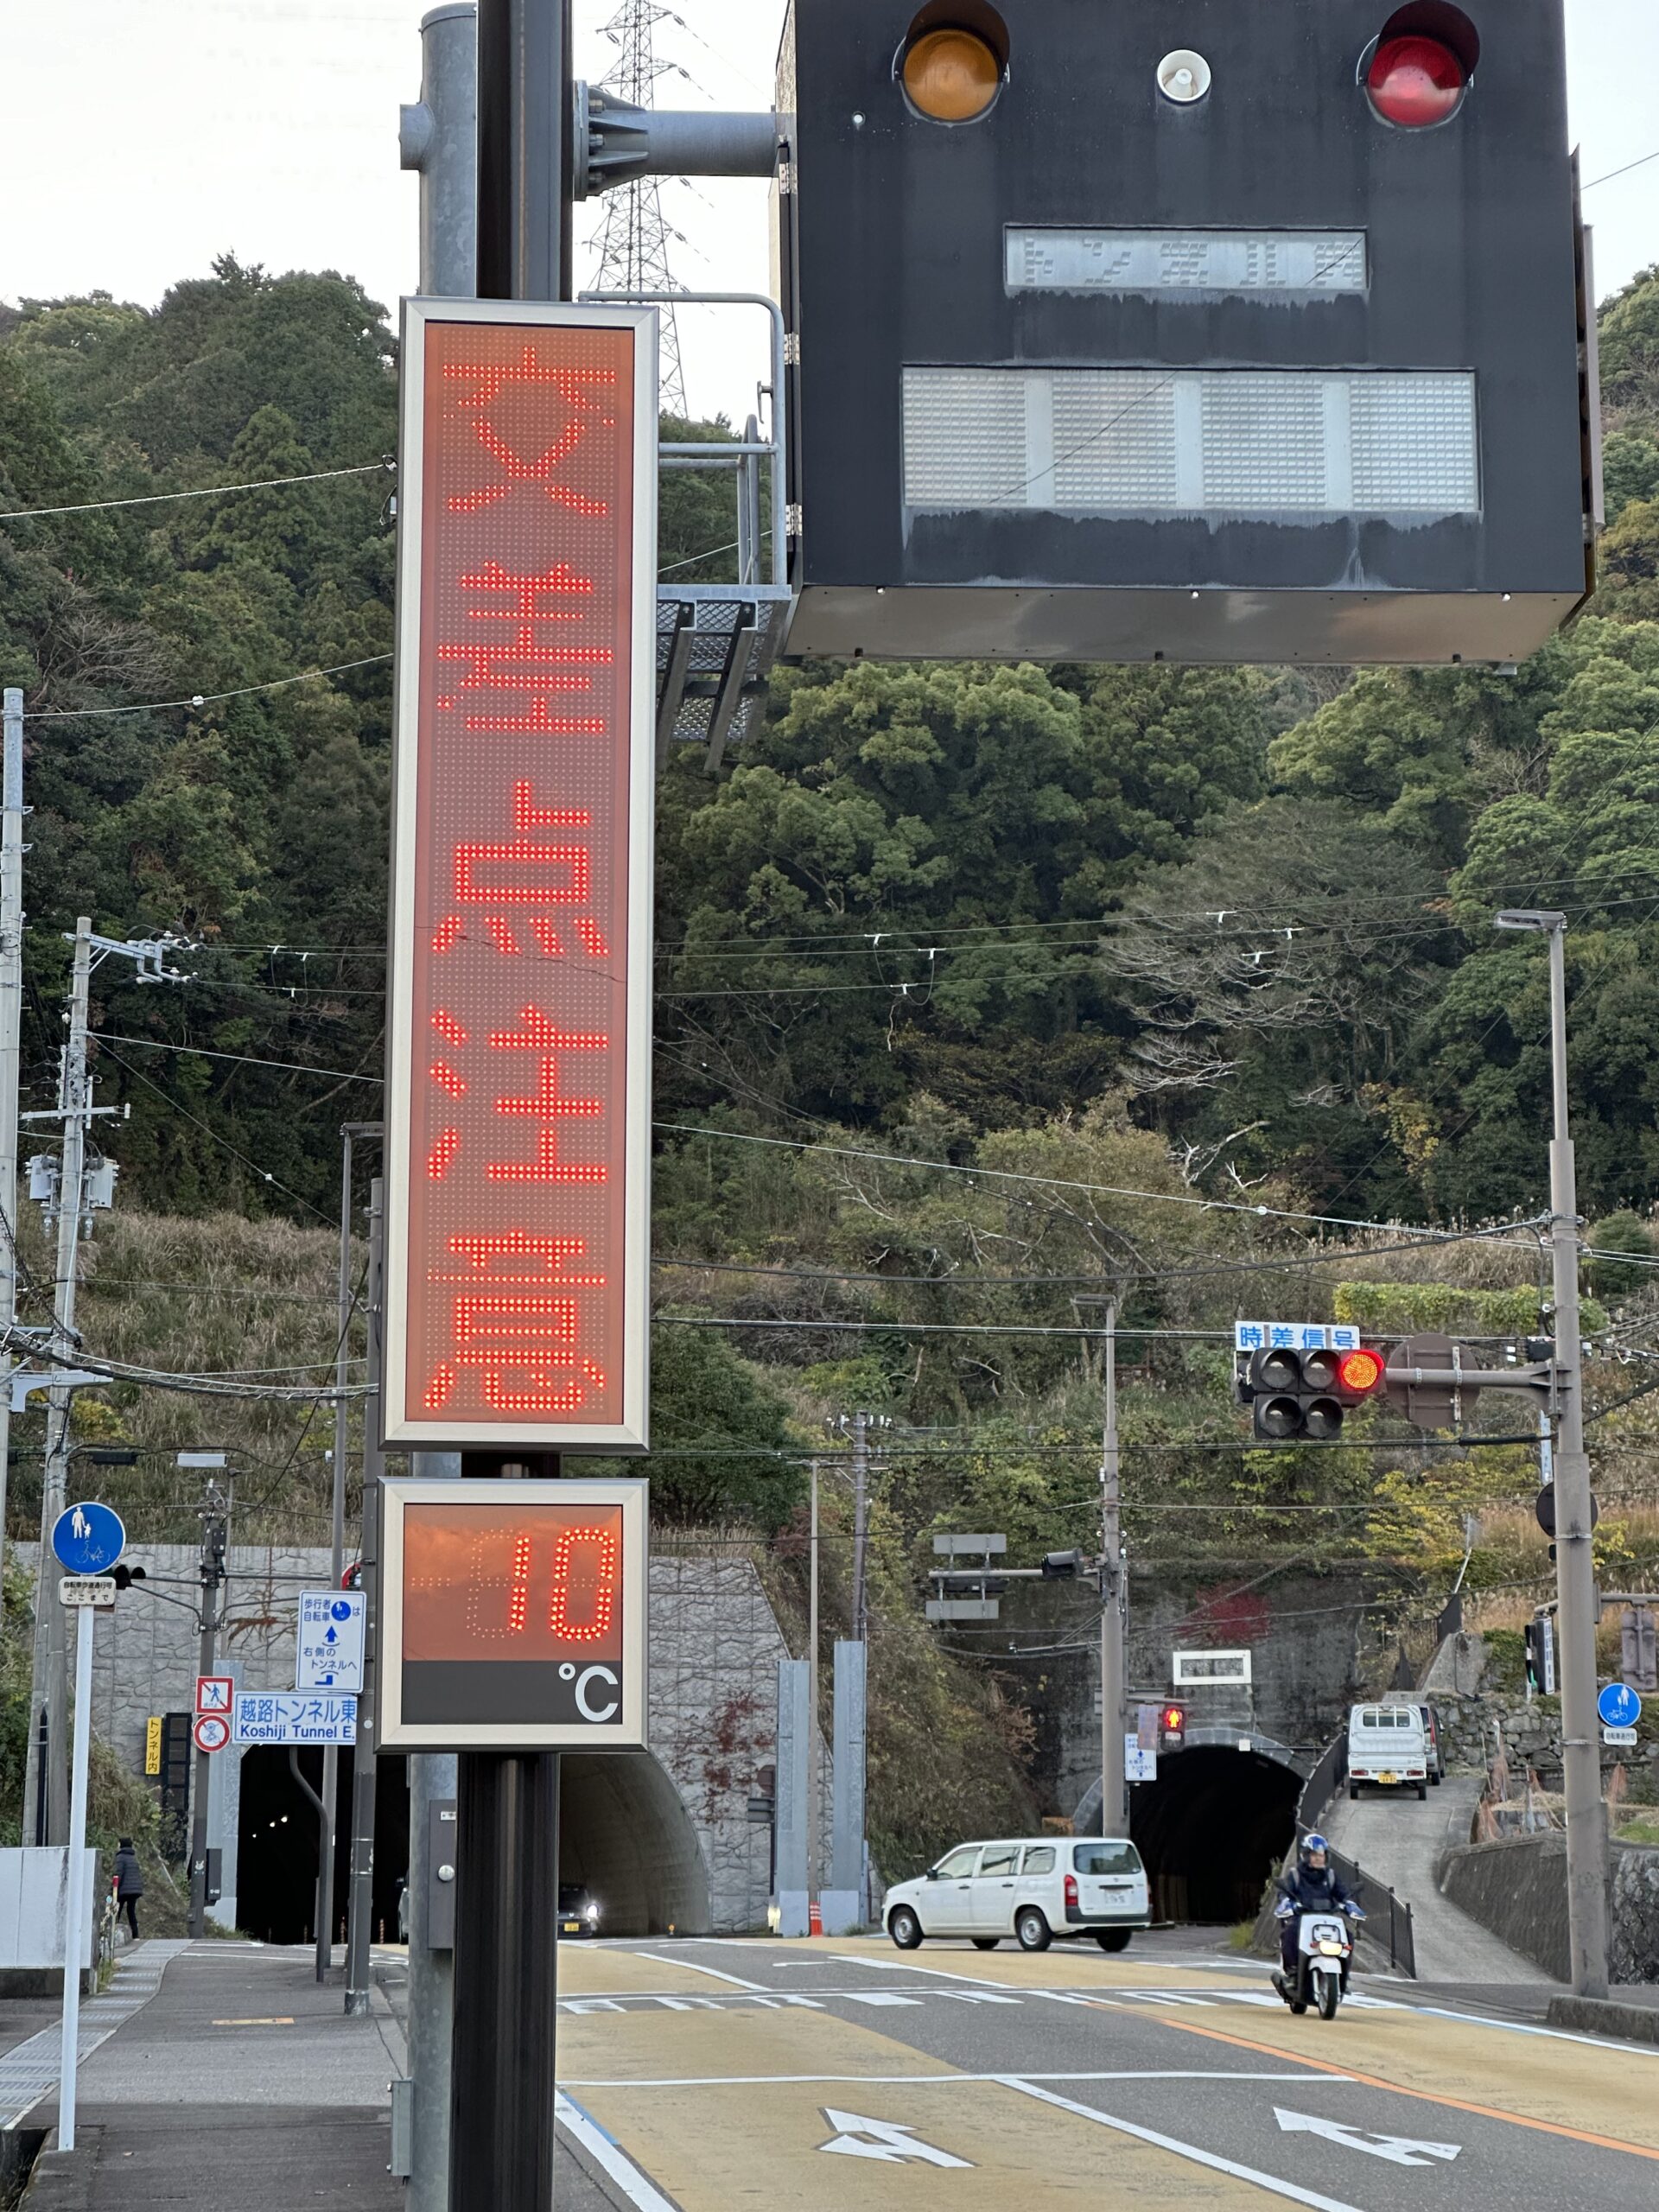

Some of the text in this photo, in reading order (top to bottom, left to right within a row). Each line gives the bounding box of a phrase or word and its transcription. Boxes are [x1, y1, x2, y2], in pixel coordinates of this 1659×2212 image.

[424, 345, 616, 1410] 交差点注意
[1240, 1326, 1355, 1350] 時差信号
[510, 1527, 616, 1640] 10
[304, 1599, 331, 1610] 歩行者
[353, 1606, 360, 1617] は
[303, 1611, 330, 1622] 自転車
[303, 1647, 336, 1657] 右側の
[311, 1660, 357, 1670] トンネルへ
[239, 1698, 357, 1724] 越路トンネル東
[240, 1724, 355, 1740] Koshiji Tunnel E.
[148, 1719, 159, 1772] トンネル内
